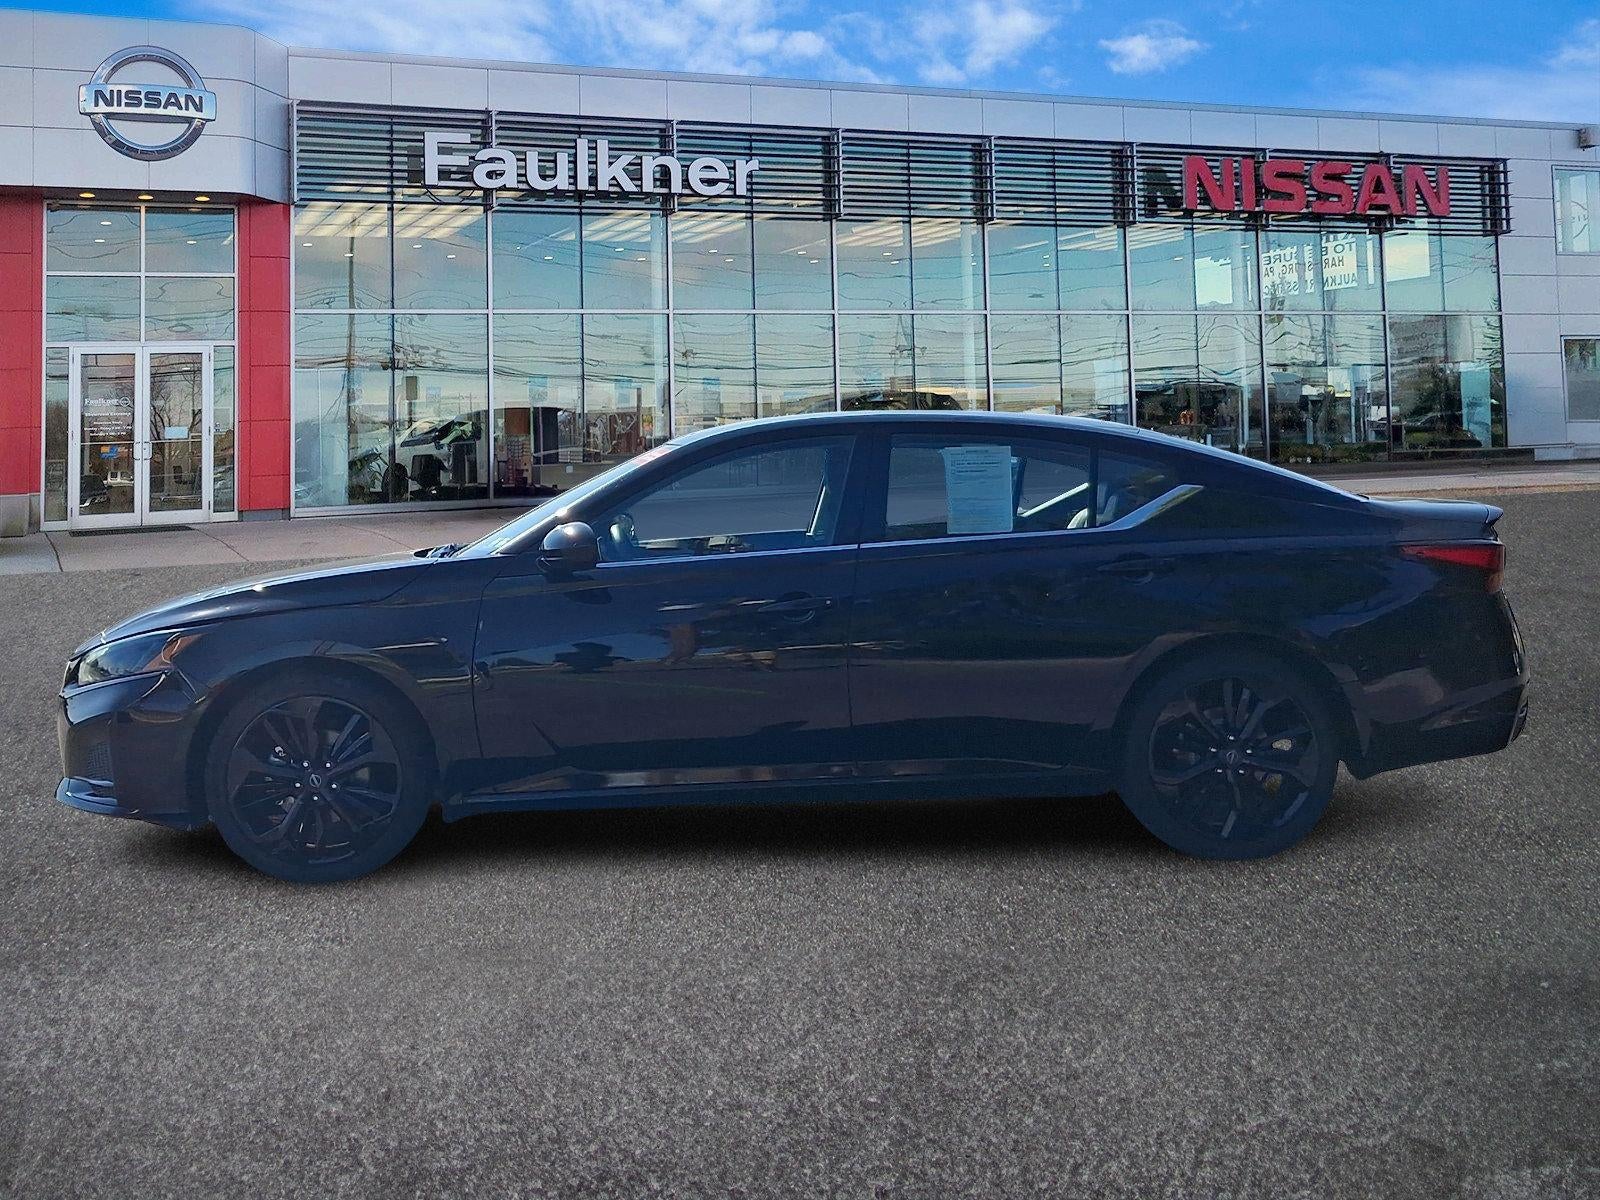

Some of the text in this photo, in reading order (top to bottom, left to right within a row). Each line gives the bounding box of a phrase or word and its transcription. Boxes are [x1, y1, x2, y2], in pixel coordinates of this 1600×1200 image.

[94, 89, 203, 113] NISSAN
[423, 131, 759, 196] Faulkner
[1182, 156, 1451, 217] NISSAN
